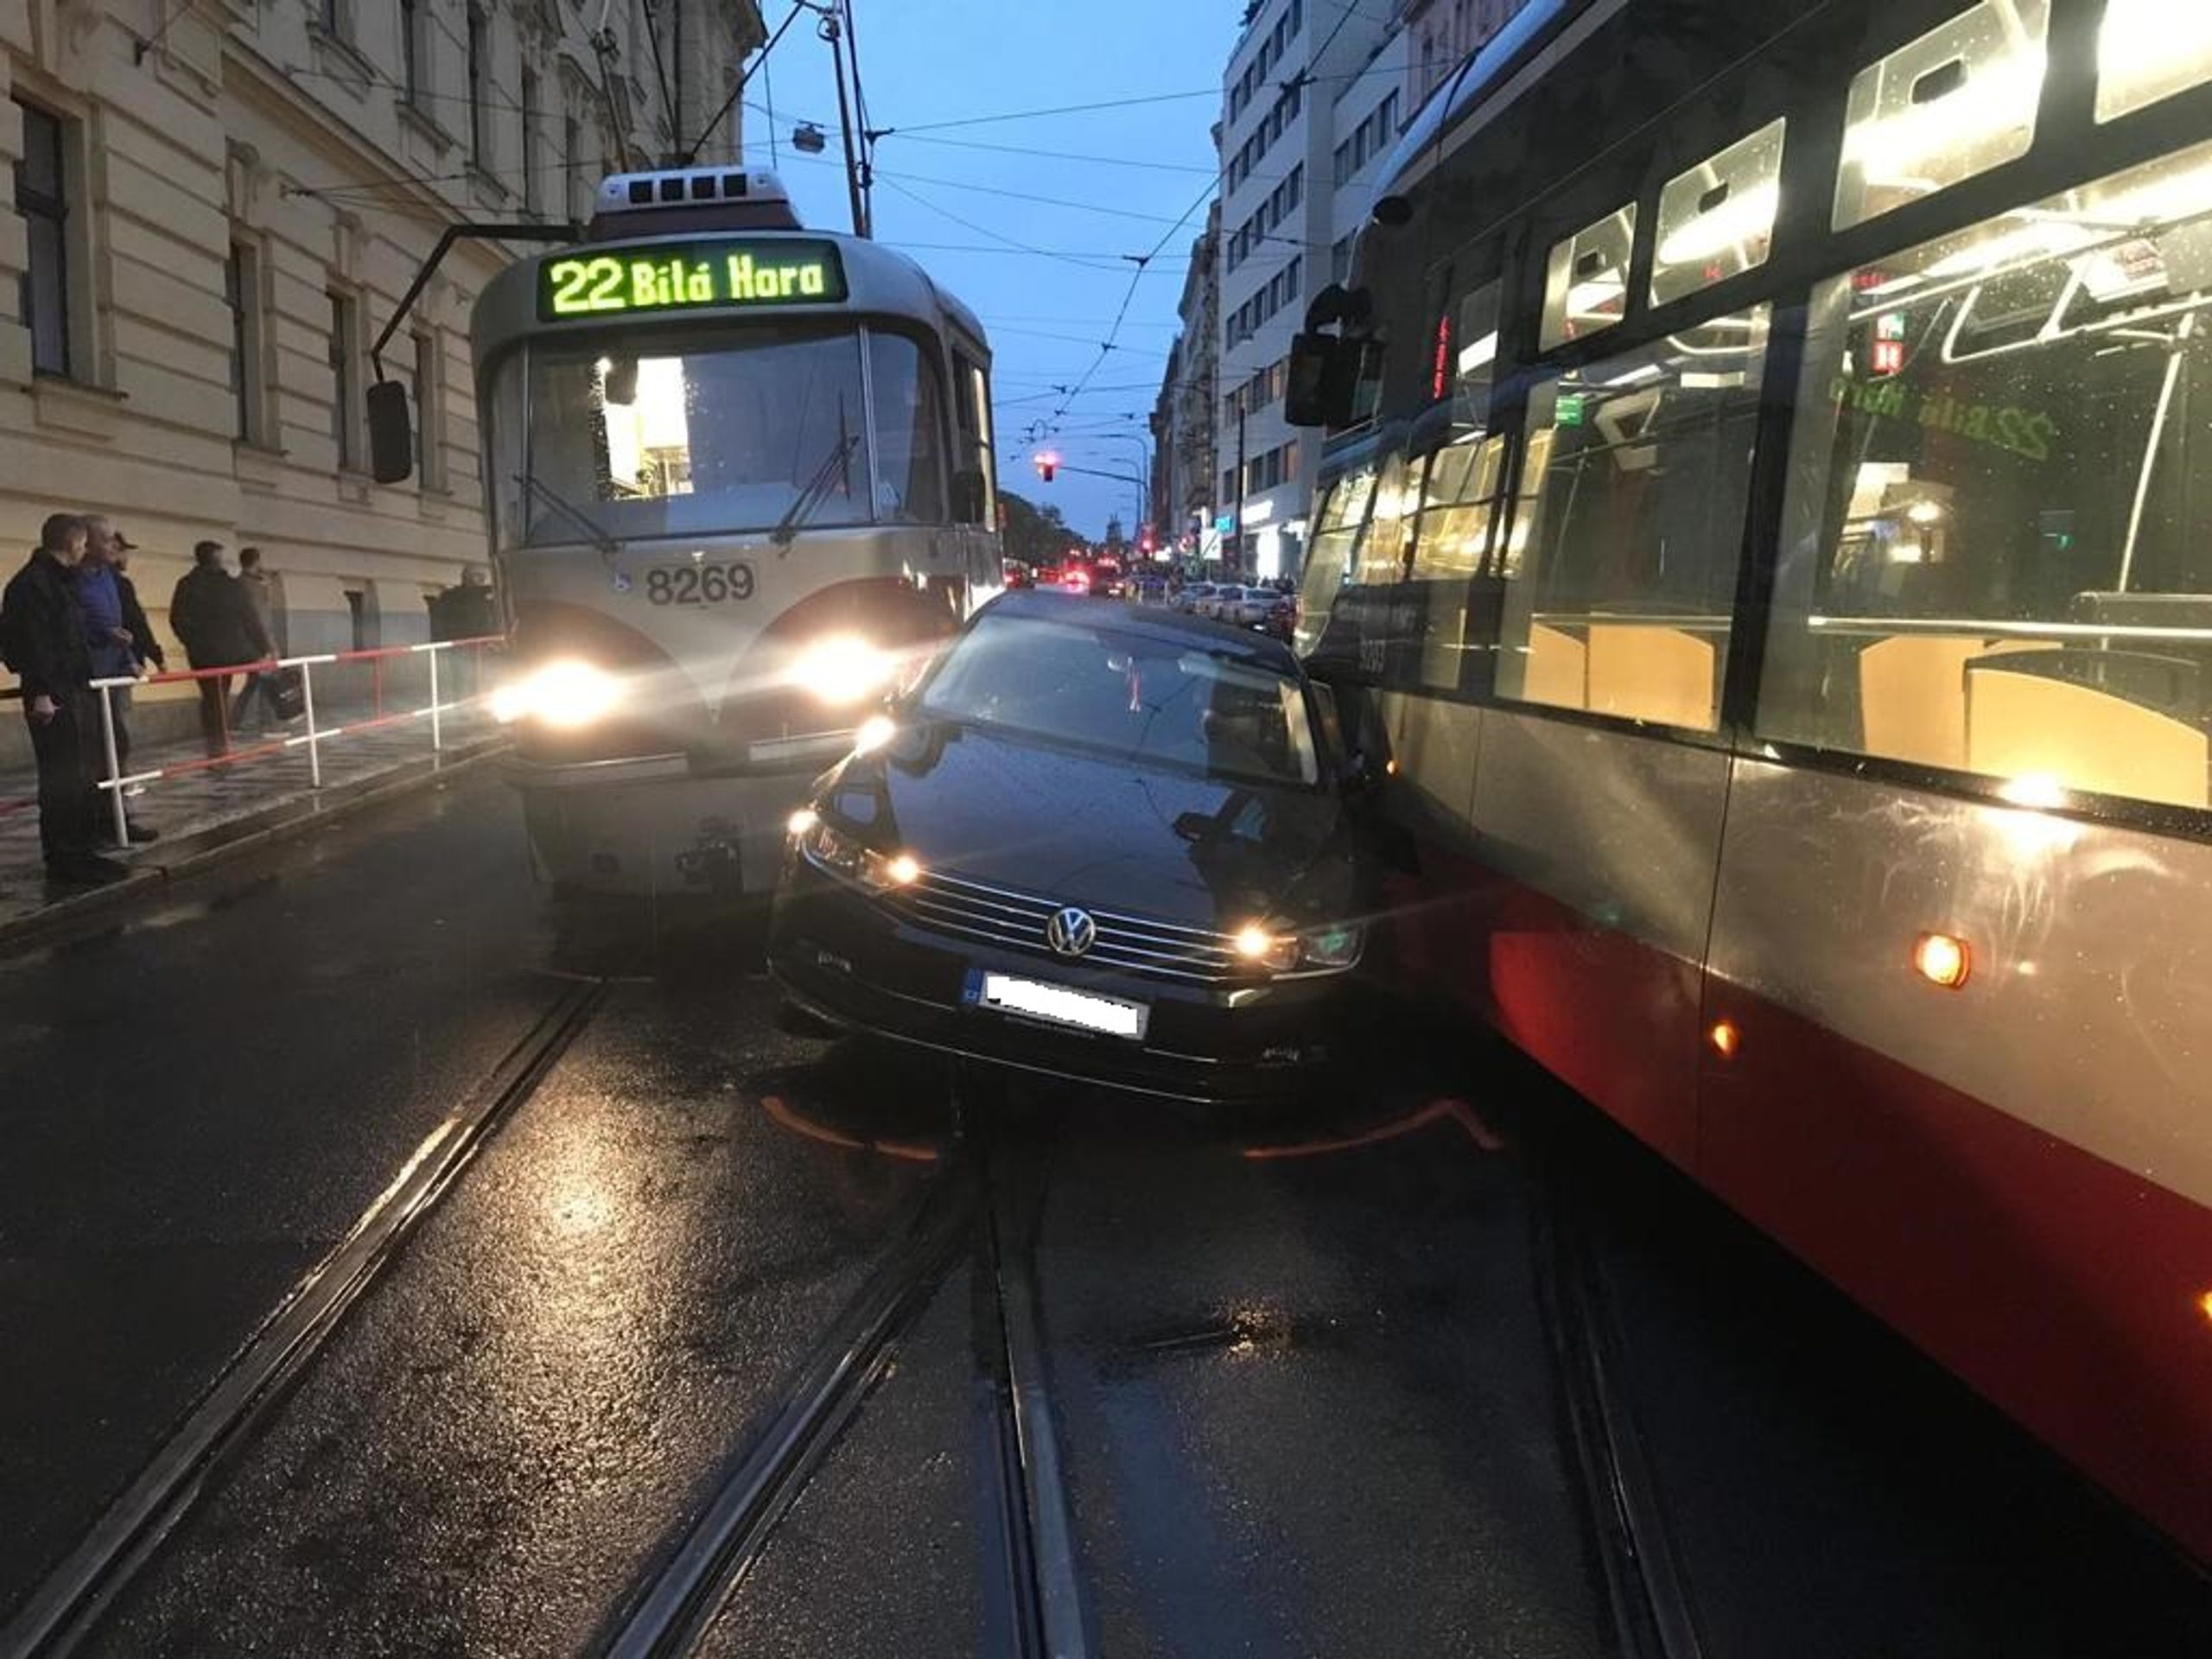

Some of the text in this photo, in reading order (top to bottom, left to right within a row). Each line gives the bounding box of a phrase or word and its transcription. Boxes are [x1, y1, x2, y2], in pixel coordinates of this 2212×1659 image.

[550, 254, 823, 312] 22 Bílá Hora
[647, 563, 754, 606] 8269
